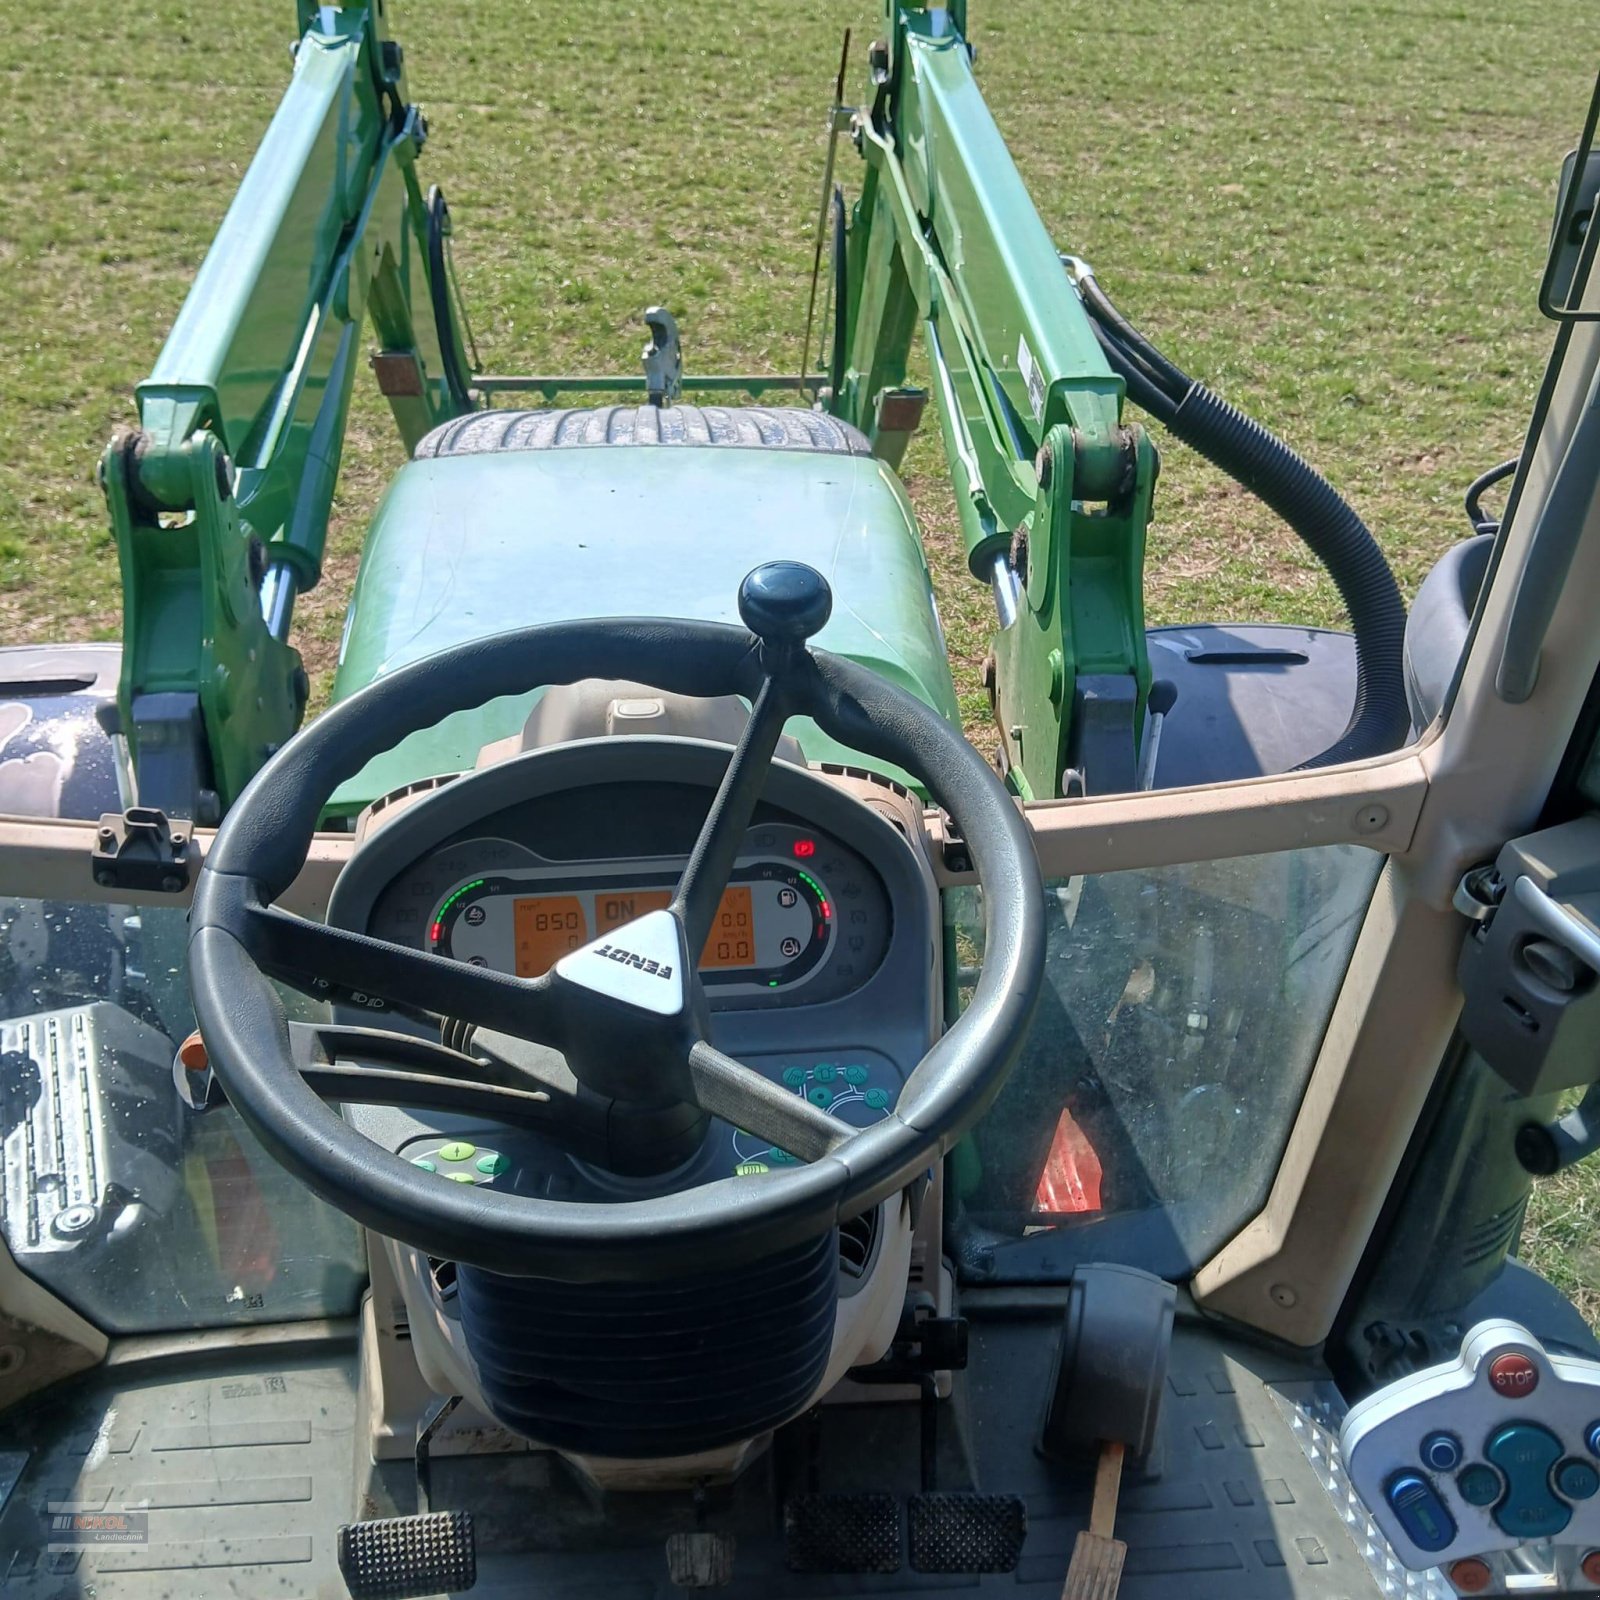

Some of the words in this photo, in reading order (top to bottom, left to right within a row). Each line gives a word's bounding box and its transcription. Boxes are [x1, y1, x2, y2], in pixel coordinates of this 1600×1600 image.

[605, 900, 635, 920] ON
[721, 912, 747, 927] 0.0
[536, 912, 578, 931] 850
[718, 941, 749, 960] 0.0
[593, 944, 673, 980] FENDT
[1496, 1370, 1534, 1386] STOP
